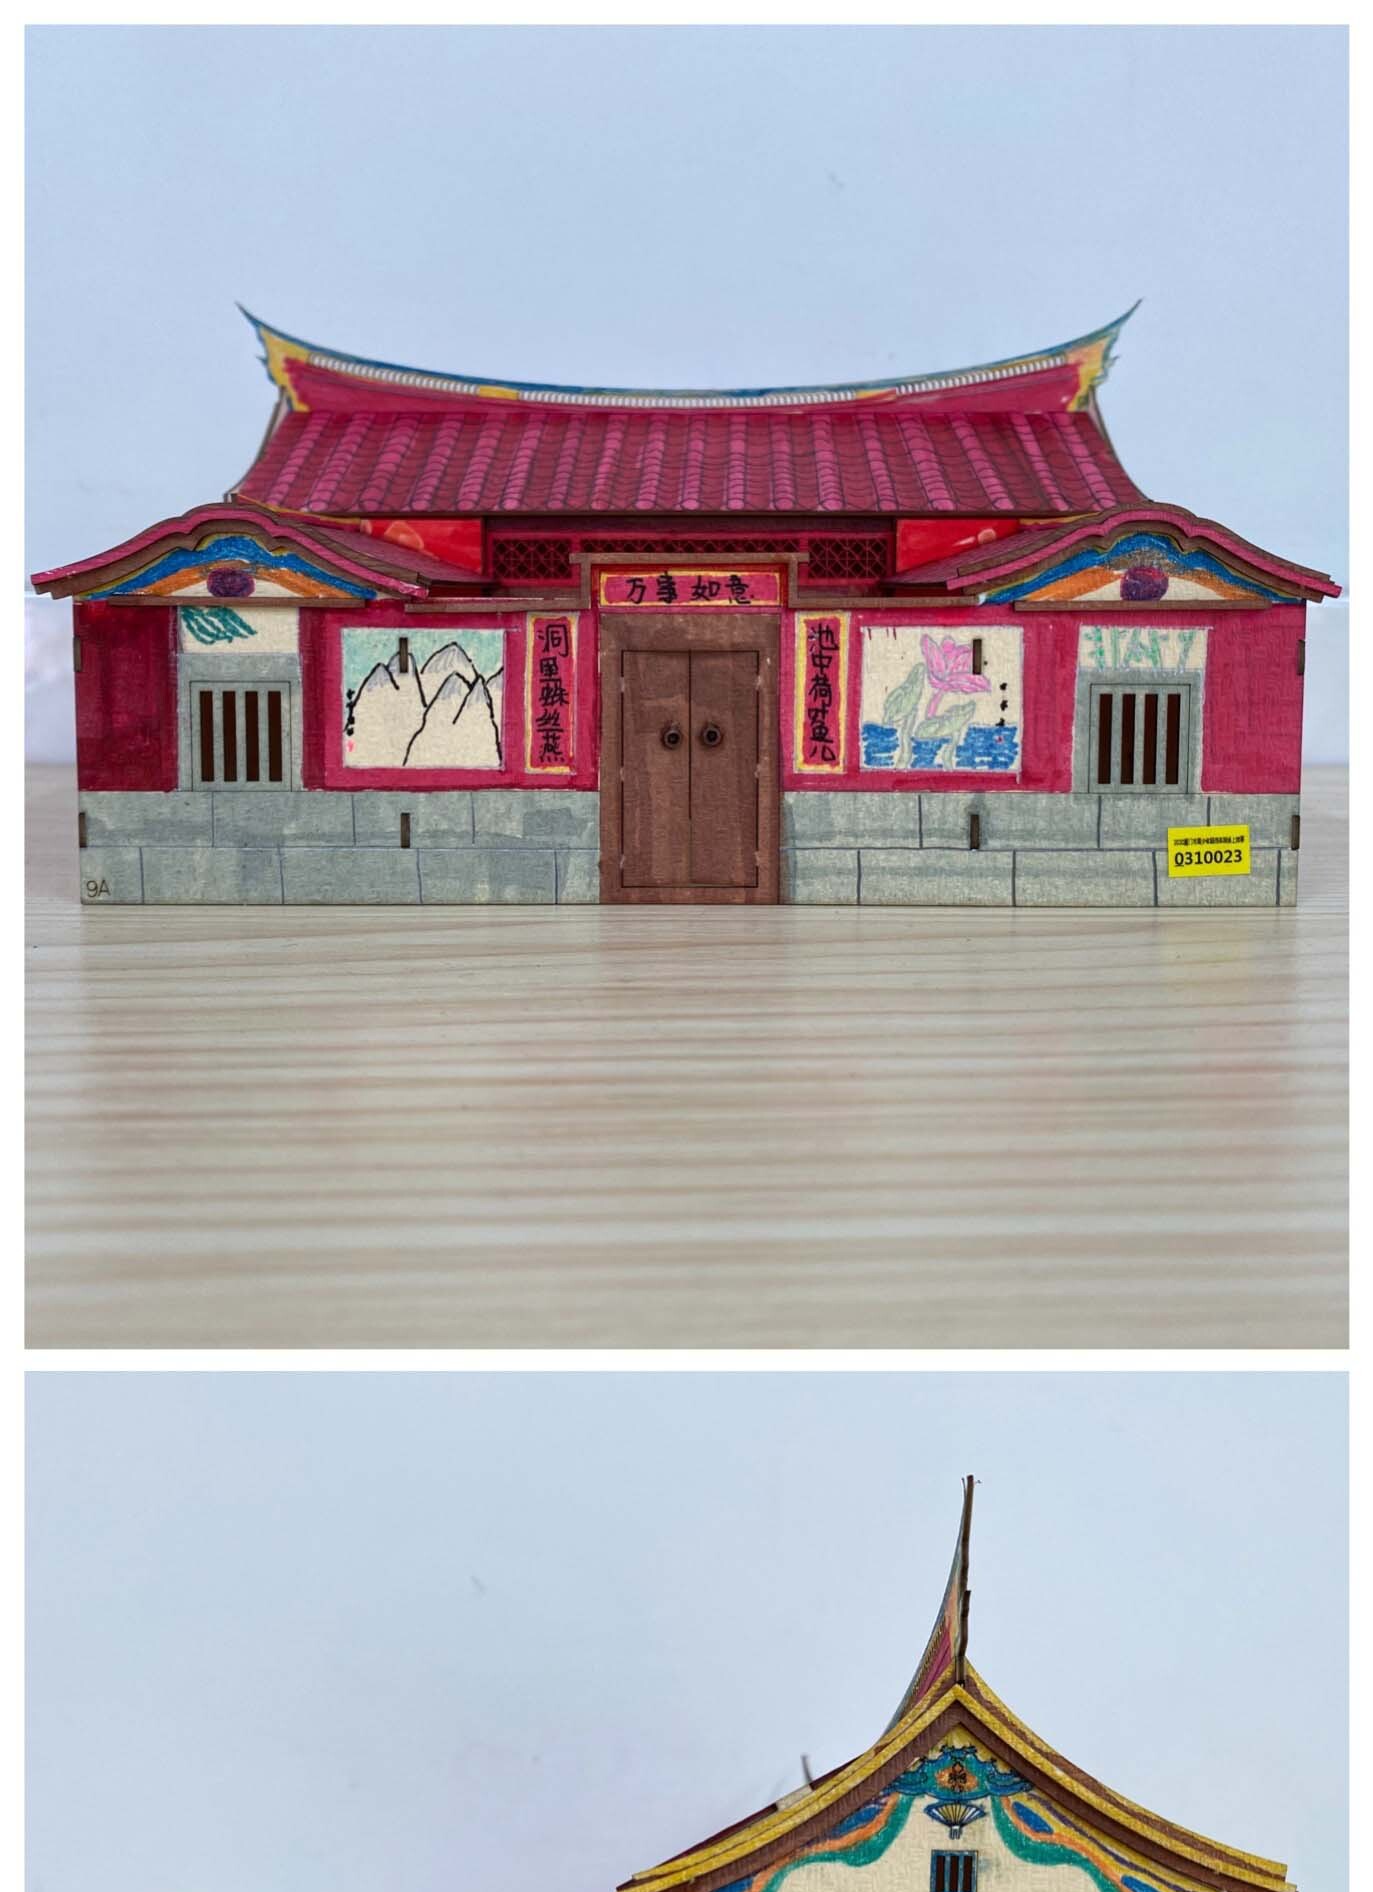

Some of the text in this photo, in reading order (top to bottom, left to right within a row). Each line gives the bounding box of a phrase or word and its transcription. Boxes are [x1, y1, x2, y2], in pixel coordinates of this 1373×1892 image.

[626, 572, 752, 604] 万事如意
[1173, 849, 1243, 867] 0310023
[86, 879, 111, 898] 9A
